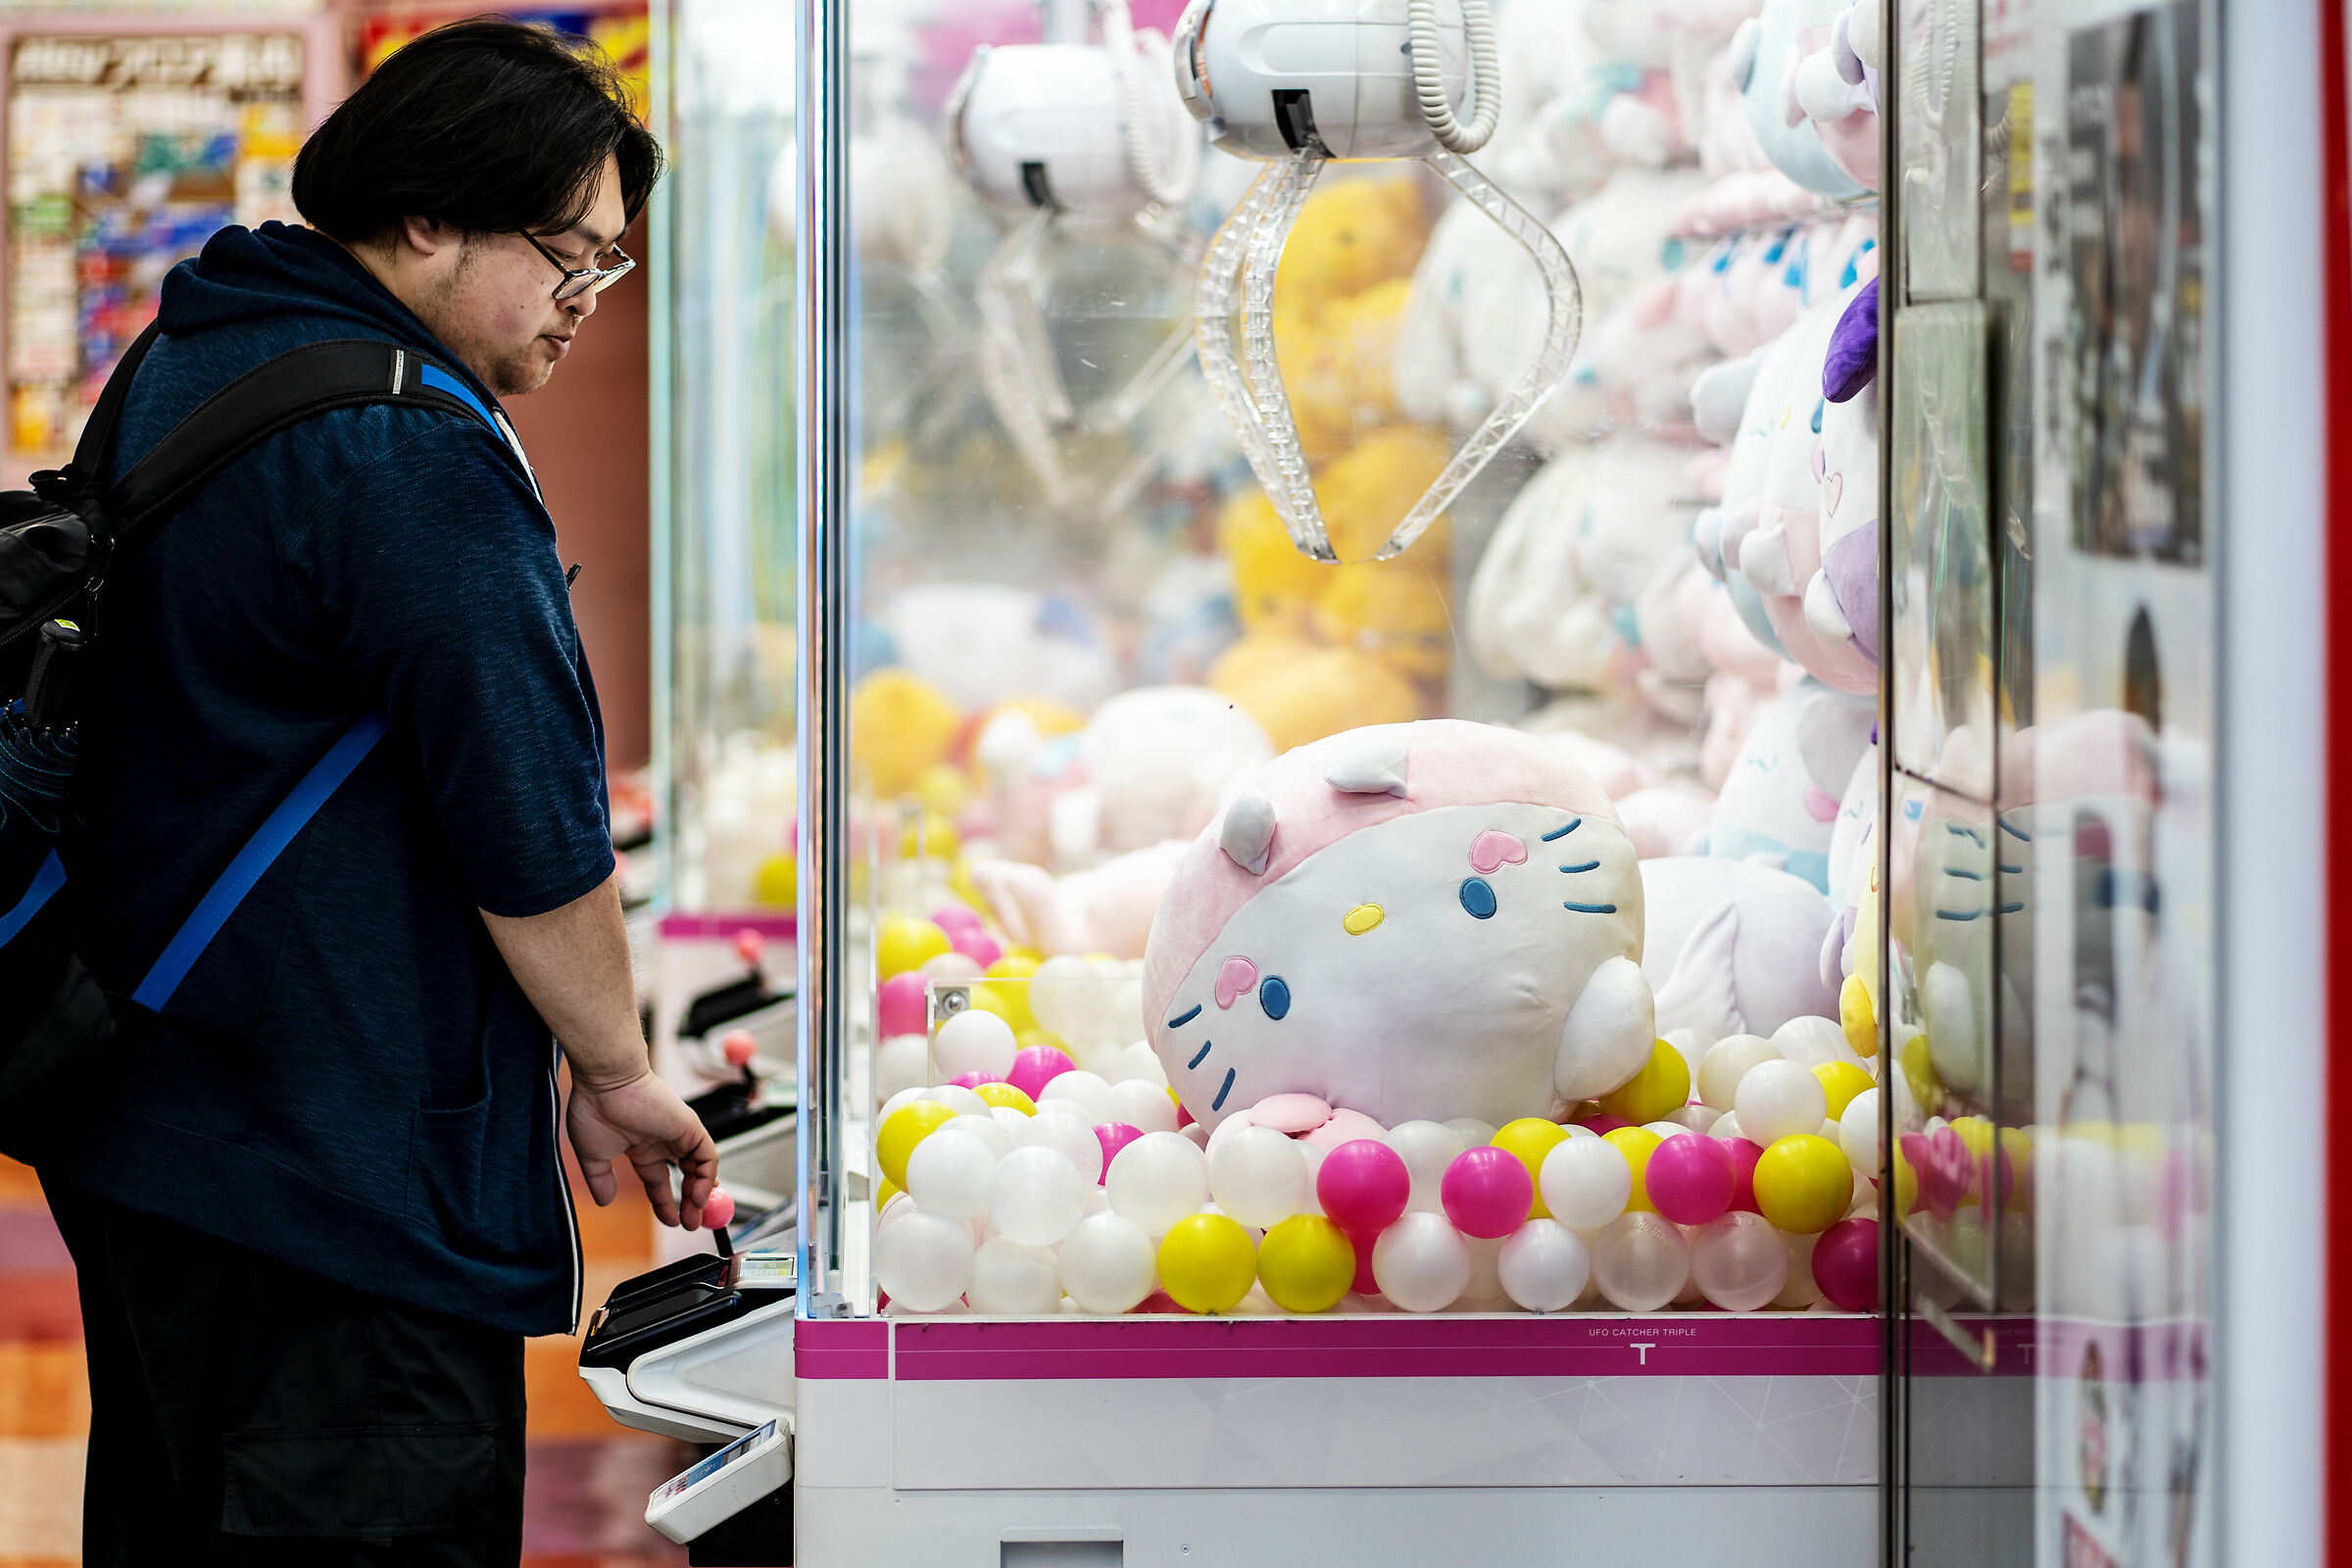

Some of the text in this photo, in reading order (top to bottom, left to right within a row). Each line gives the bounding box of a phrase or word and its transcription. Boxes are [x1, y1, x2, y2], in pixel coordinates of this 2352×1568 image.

[1589, 1328, 1696, 1337] UFO CATCHER TRIPLE
[1630, 1344, 1655, 1365] T
